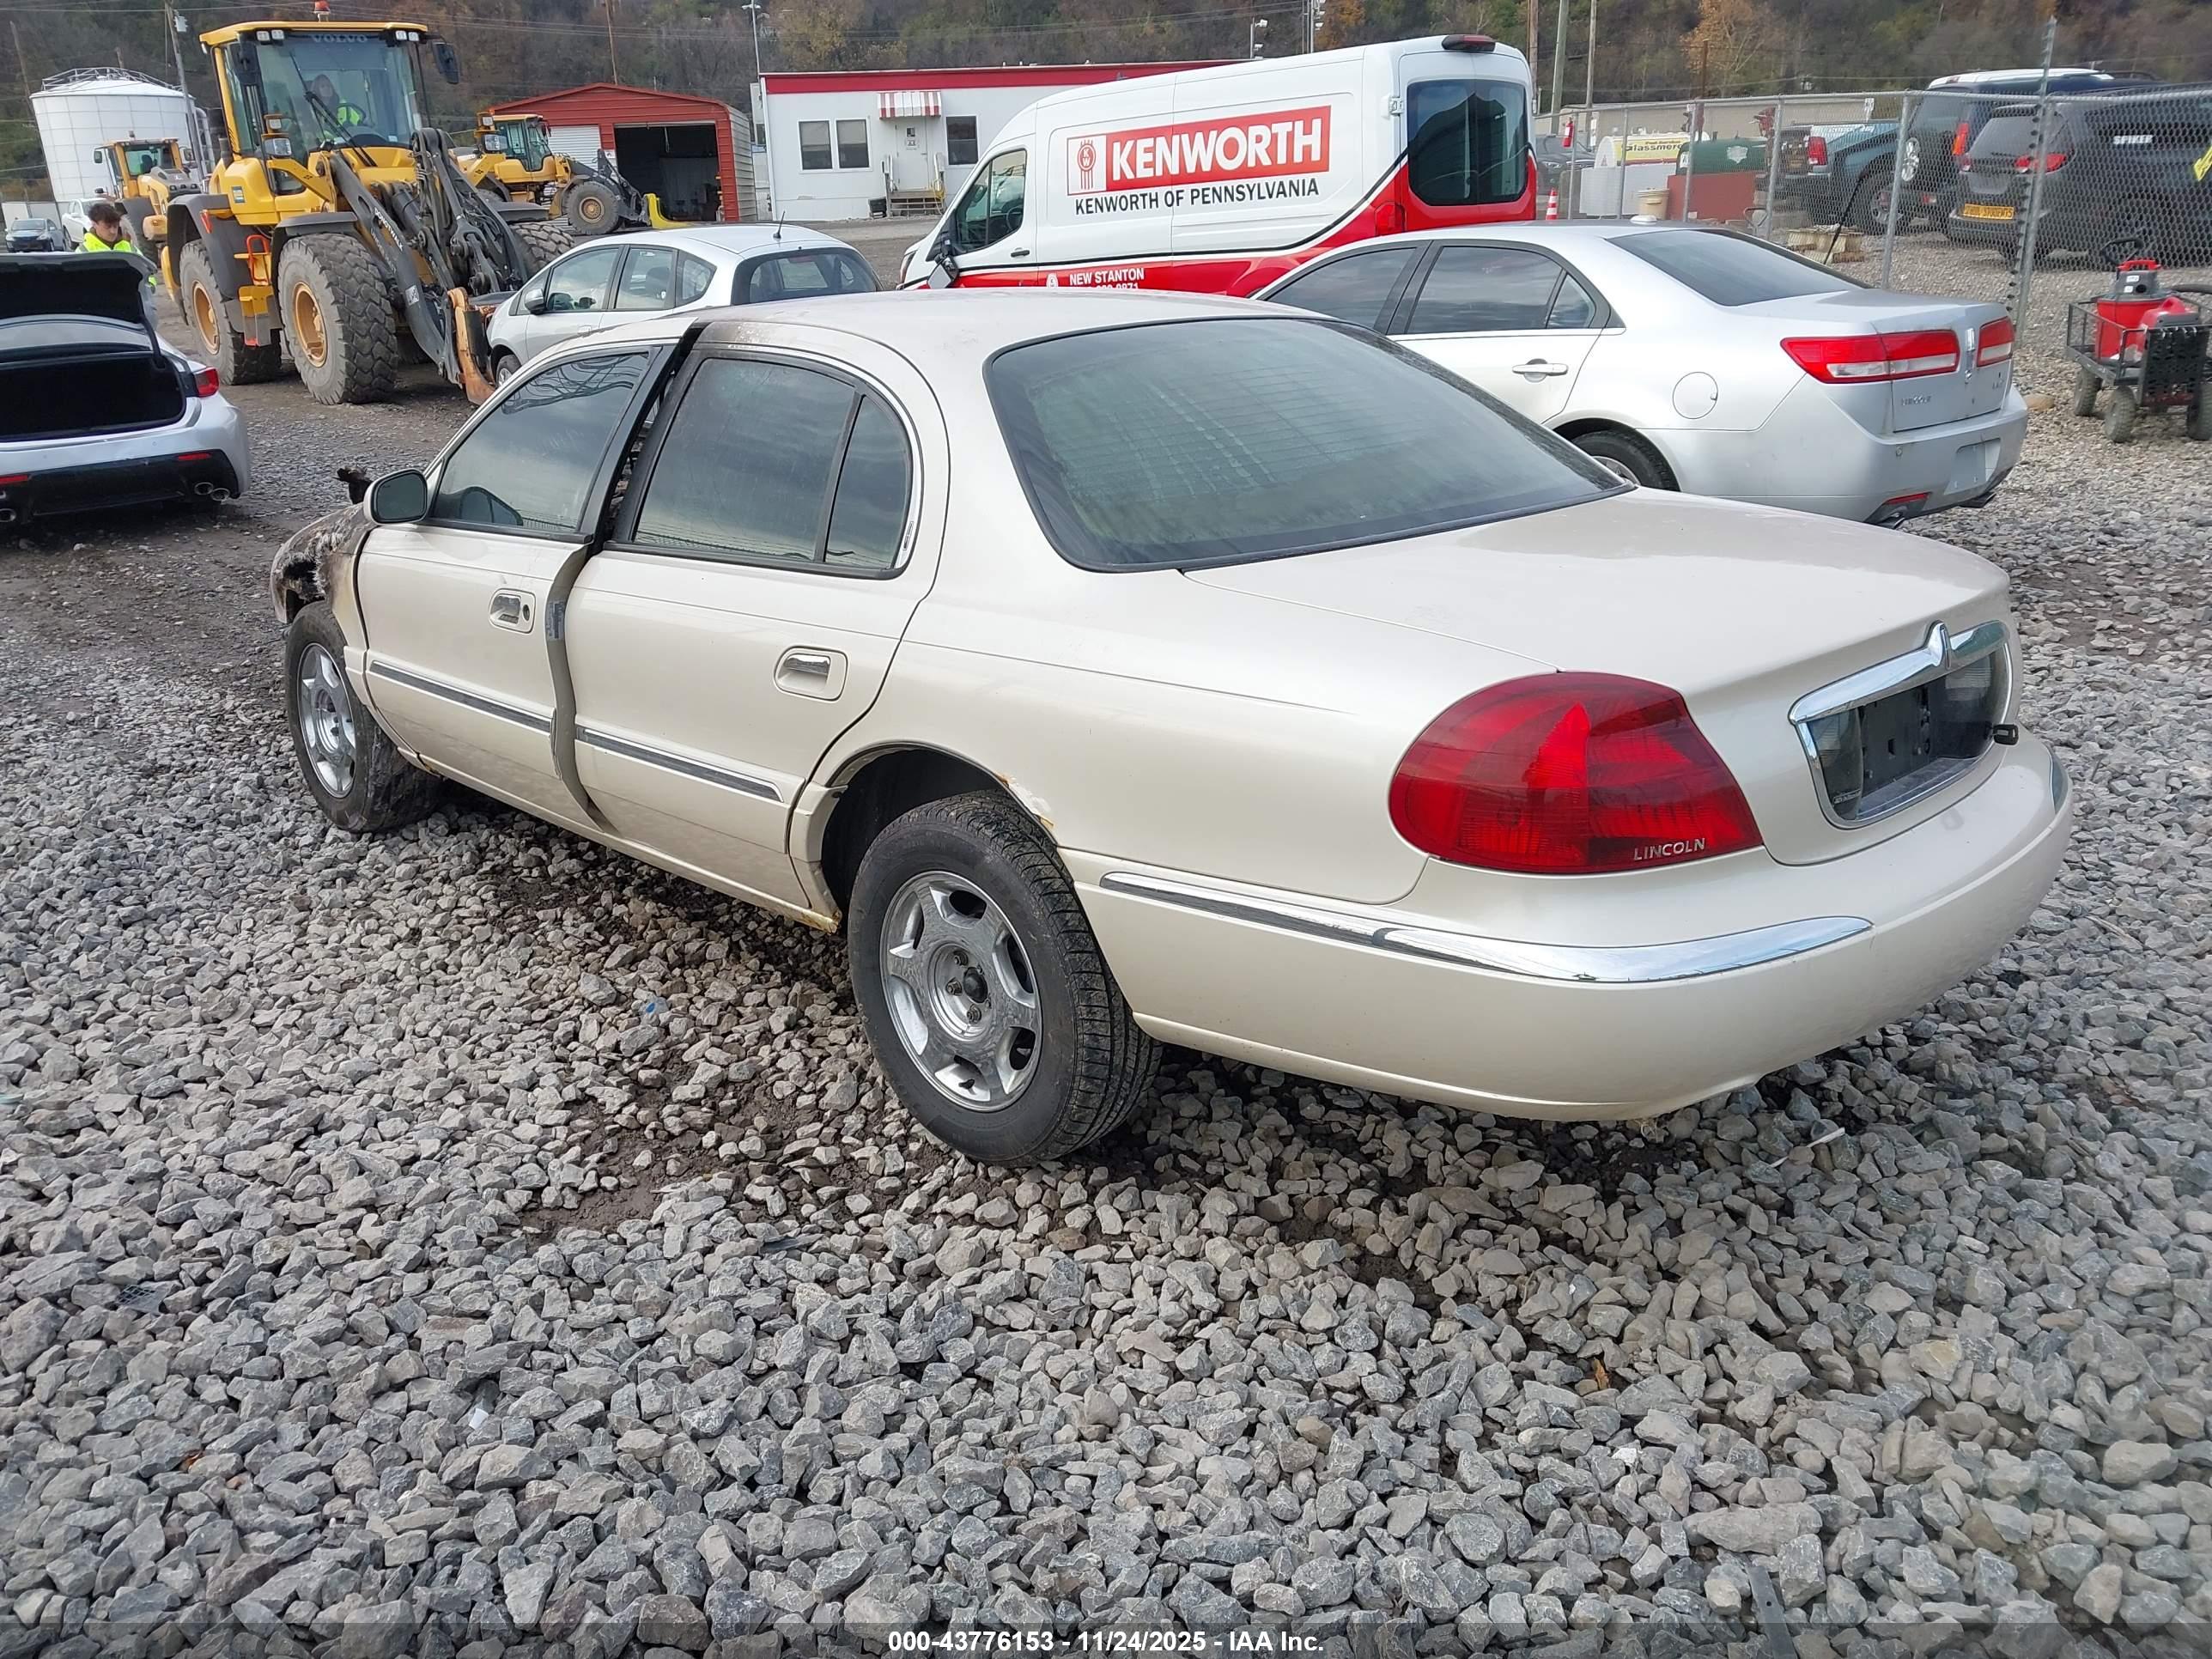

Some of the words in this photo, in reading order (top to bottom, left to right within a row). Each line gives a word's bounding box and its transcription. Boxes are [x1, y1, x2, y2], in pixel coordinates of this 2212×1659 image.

[311, 33, 368, 43] VOLVO
[1113, 118, 1322, 181] KENWORTH
[1075, 191, 1159, 216] KENWORTH
[1164, 189, 1185, 208] OF
[1190, 177, 1320, 206] PENNSYLVANIA
[1069, 271, 1093, 286] NEW
[1094, 267, 1146, 284] STANTON
[1633, 837, 1705, 861] LINCOLN
